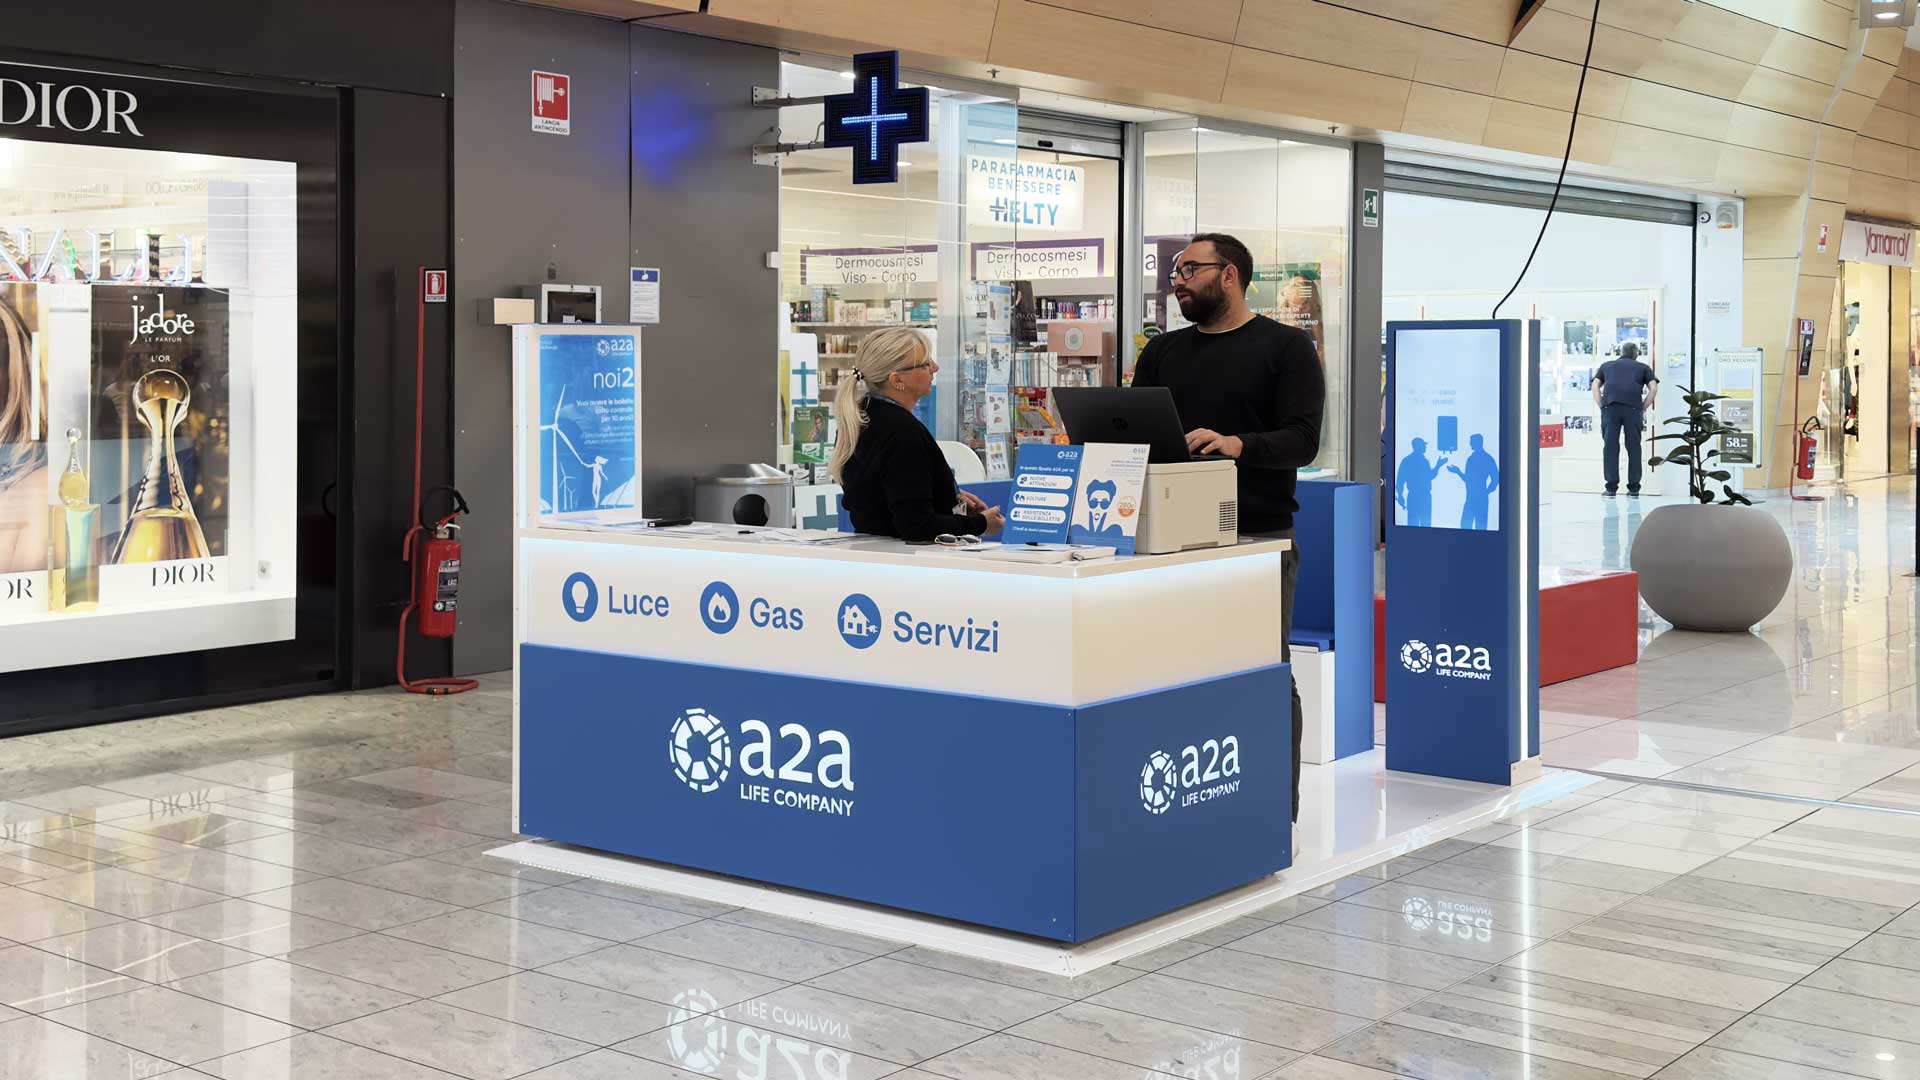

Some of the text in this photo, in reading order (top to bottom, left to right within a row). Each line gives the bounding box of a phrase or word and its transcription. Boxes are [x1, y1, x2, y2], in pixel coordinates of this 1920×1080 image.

[0, 78, 144, 137] DIOR
[971, 158, 1077, 183] PARAFARMACIA
[988, 176, 1062, 196] BENESSERE
[989, 196, 1060, 226] HELTY
[835, 253, 924, 269] Dermocosmesi
[987, 247, 1088, 264] Dermocosmesi
[841, 271, 867, 284] Viso
[881, 270, 918, 283] Corpo
[994, 265, 1022, 279] Viso
[1038, 265, 1079, 278] Corpo
[611, 339, 635, 352] a2a
[151, 354, 171, 363] L'OR
[593, 366, 635, 390] noi2
[152, 562, 215, 587] DIOR
[608, 585, 670, 618] Luce
[749, 596, 804, 632] Gas
[892, 610, 999, 654] Servizi
[1435, 643, 1492, 671] a2a
[1436, 668, 1492, 681] LIFE COMPANY
[739, 719, 854, 792] a2a
[1181, 735, 1241, 789] a2a
[740, 783, 855, 817] LIFE COMPANY
[1181, 779, 1241, 808] LIFE COMPANY
